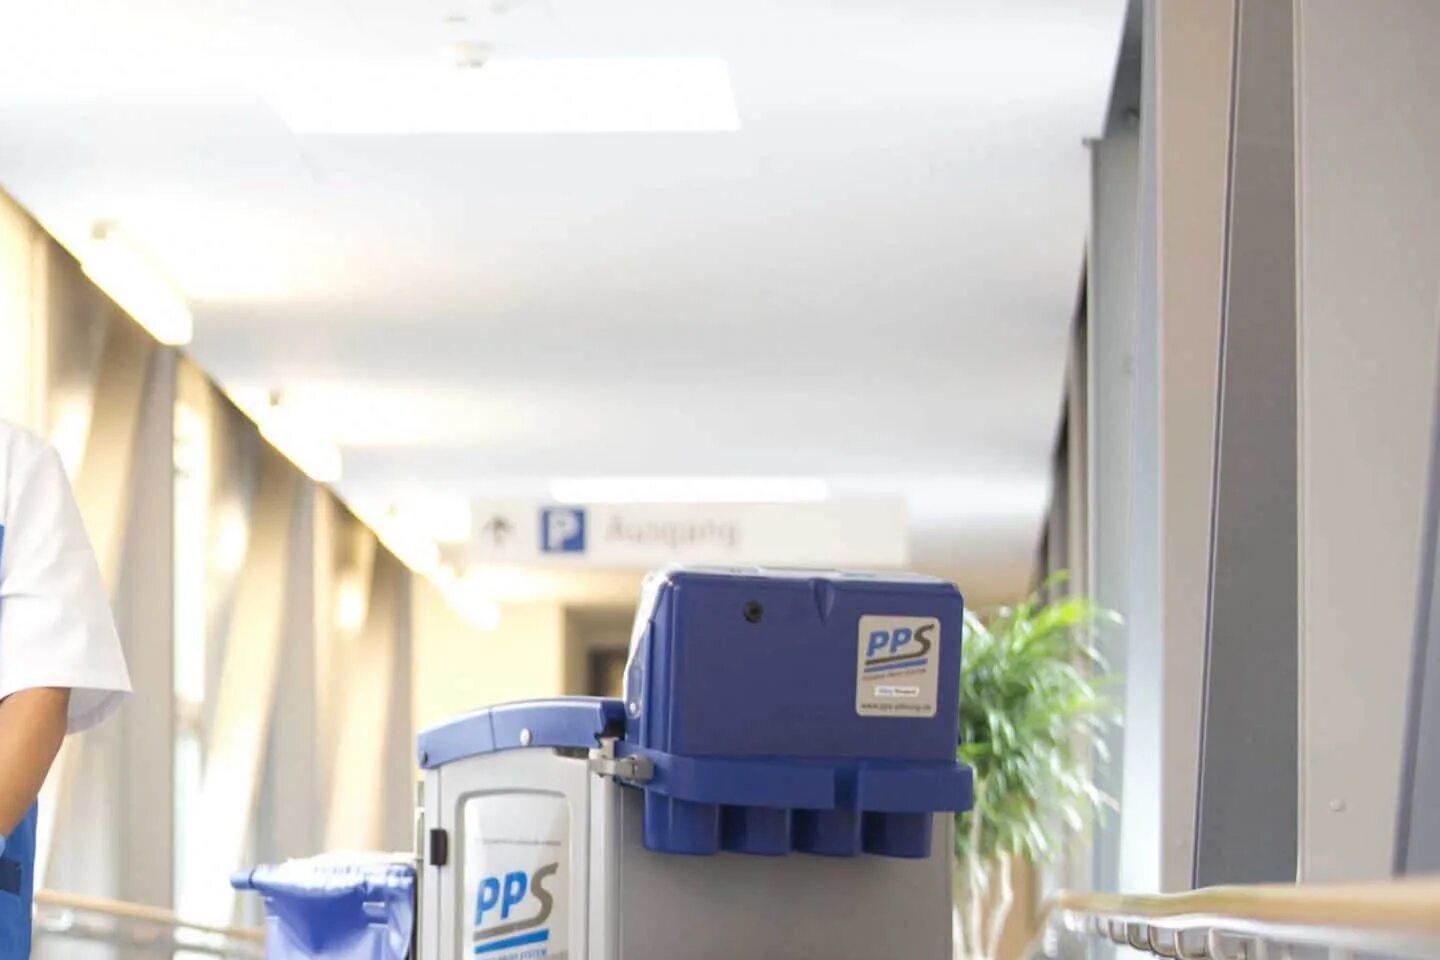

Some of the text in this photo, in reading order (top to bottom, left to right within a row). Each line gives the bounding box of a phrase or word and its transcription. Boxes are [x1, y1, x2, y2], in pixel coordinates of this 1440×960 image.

[547, 509, 738, 551] P Ausgang
[865, 624, 935, 665] PPS
[473, 862, 559, 940] PPS
